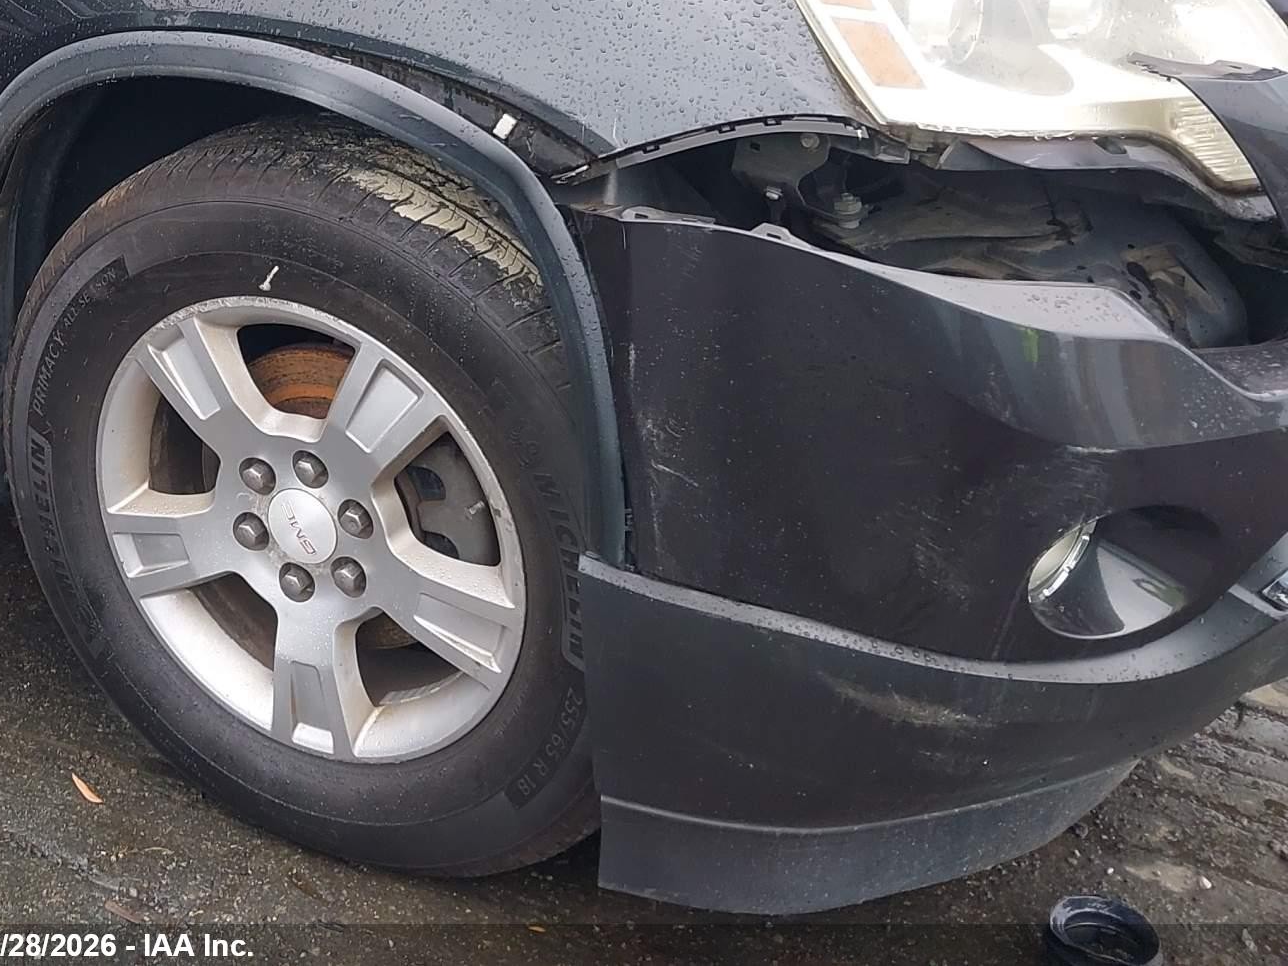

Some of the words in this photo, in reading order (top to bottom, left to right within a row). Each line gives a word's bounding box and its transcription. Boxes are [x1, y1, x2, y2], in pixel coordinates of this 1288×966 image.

[32, 329, 66, 416] PRIMACY
[63, 305, 81, 331] ALL
[78, 267, 117, 307] SESON
[280, 498, 317, 555] GMC
[545, 686, 584, 761] 255/65
[517, 773, 537, 796] 18
[532, 756, 549, 777] R
